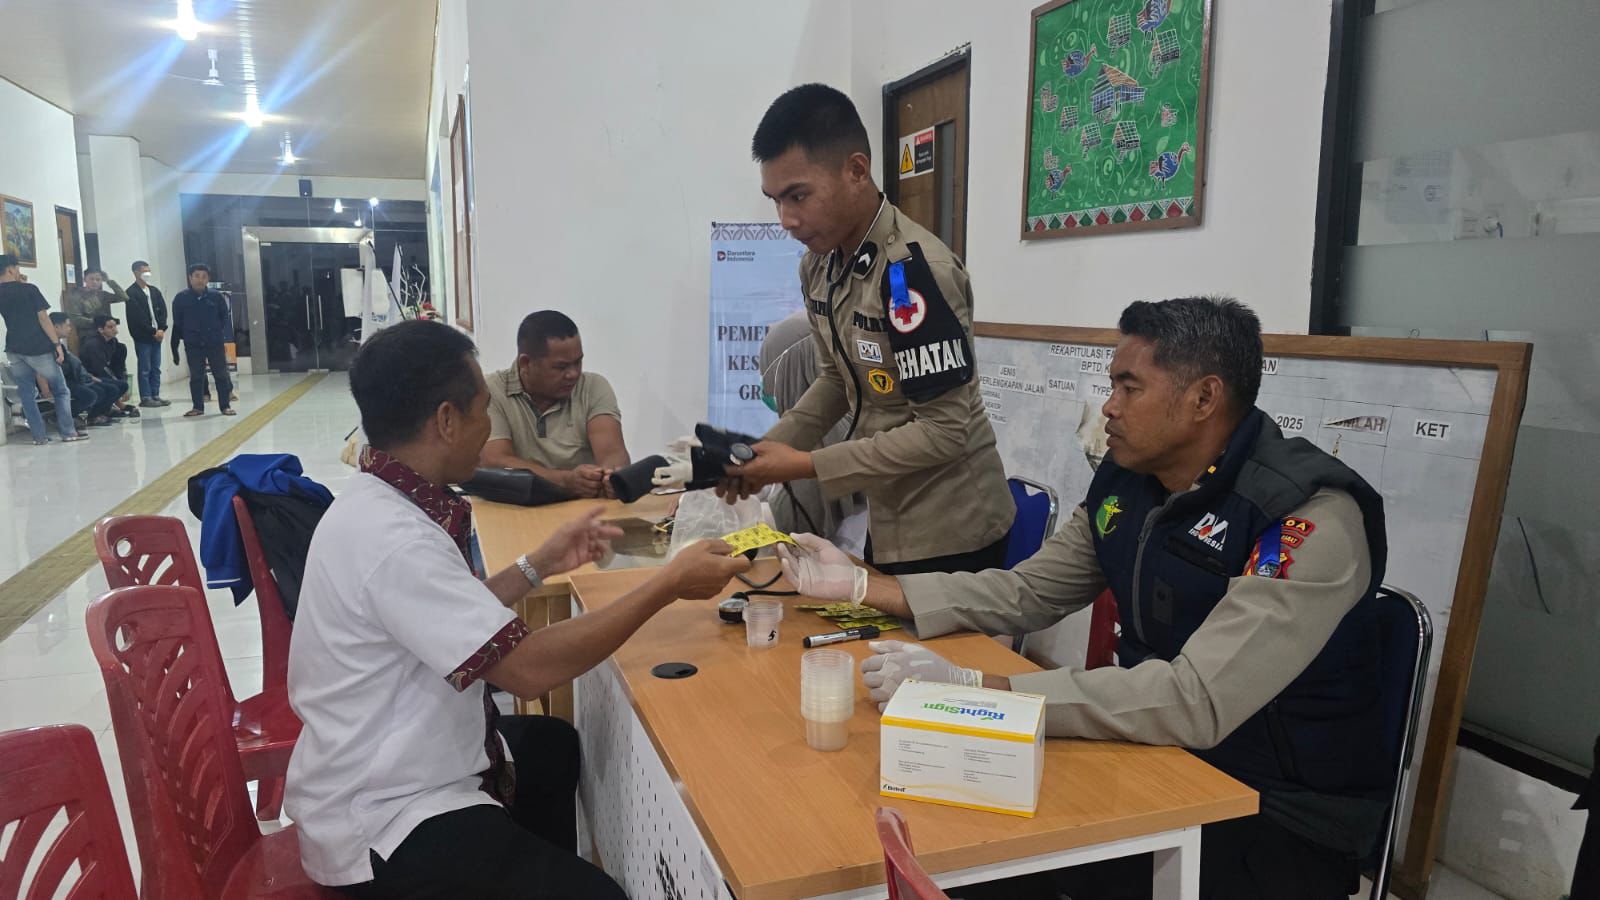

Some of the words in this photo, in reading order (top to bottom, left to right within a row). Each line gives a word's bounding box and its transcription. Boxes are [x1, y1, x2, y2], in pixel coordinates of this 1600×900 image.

[1050, 345, 1104, 359] REKAPITULASI
[1000, 367, 1016, 377] JENIS
[1081, 360, 1102, 373] BPTD
[1024, 383, 1045, 395] JALAN
[1048, 379, 1075, 392] SATUAN
[1276, 415, 1304, 431] 2025
[1415, 421, 1449, 439] KET
[922, 702, 1006, 721] RightSign
